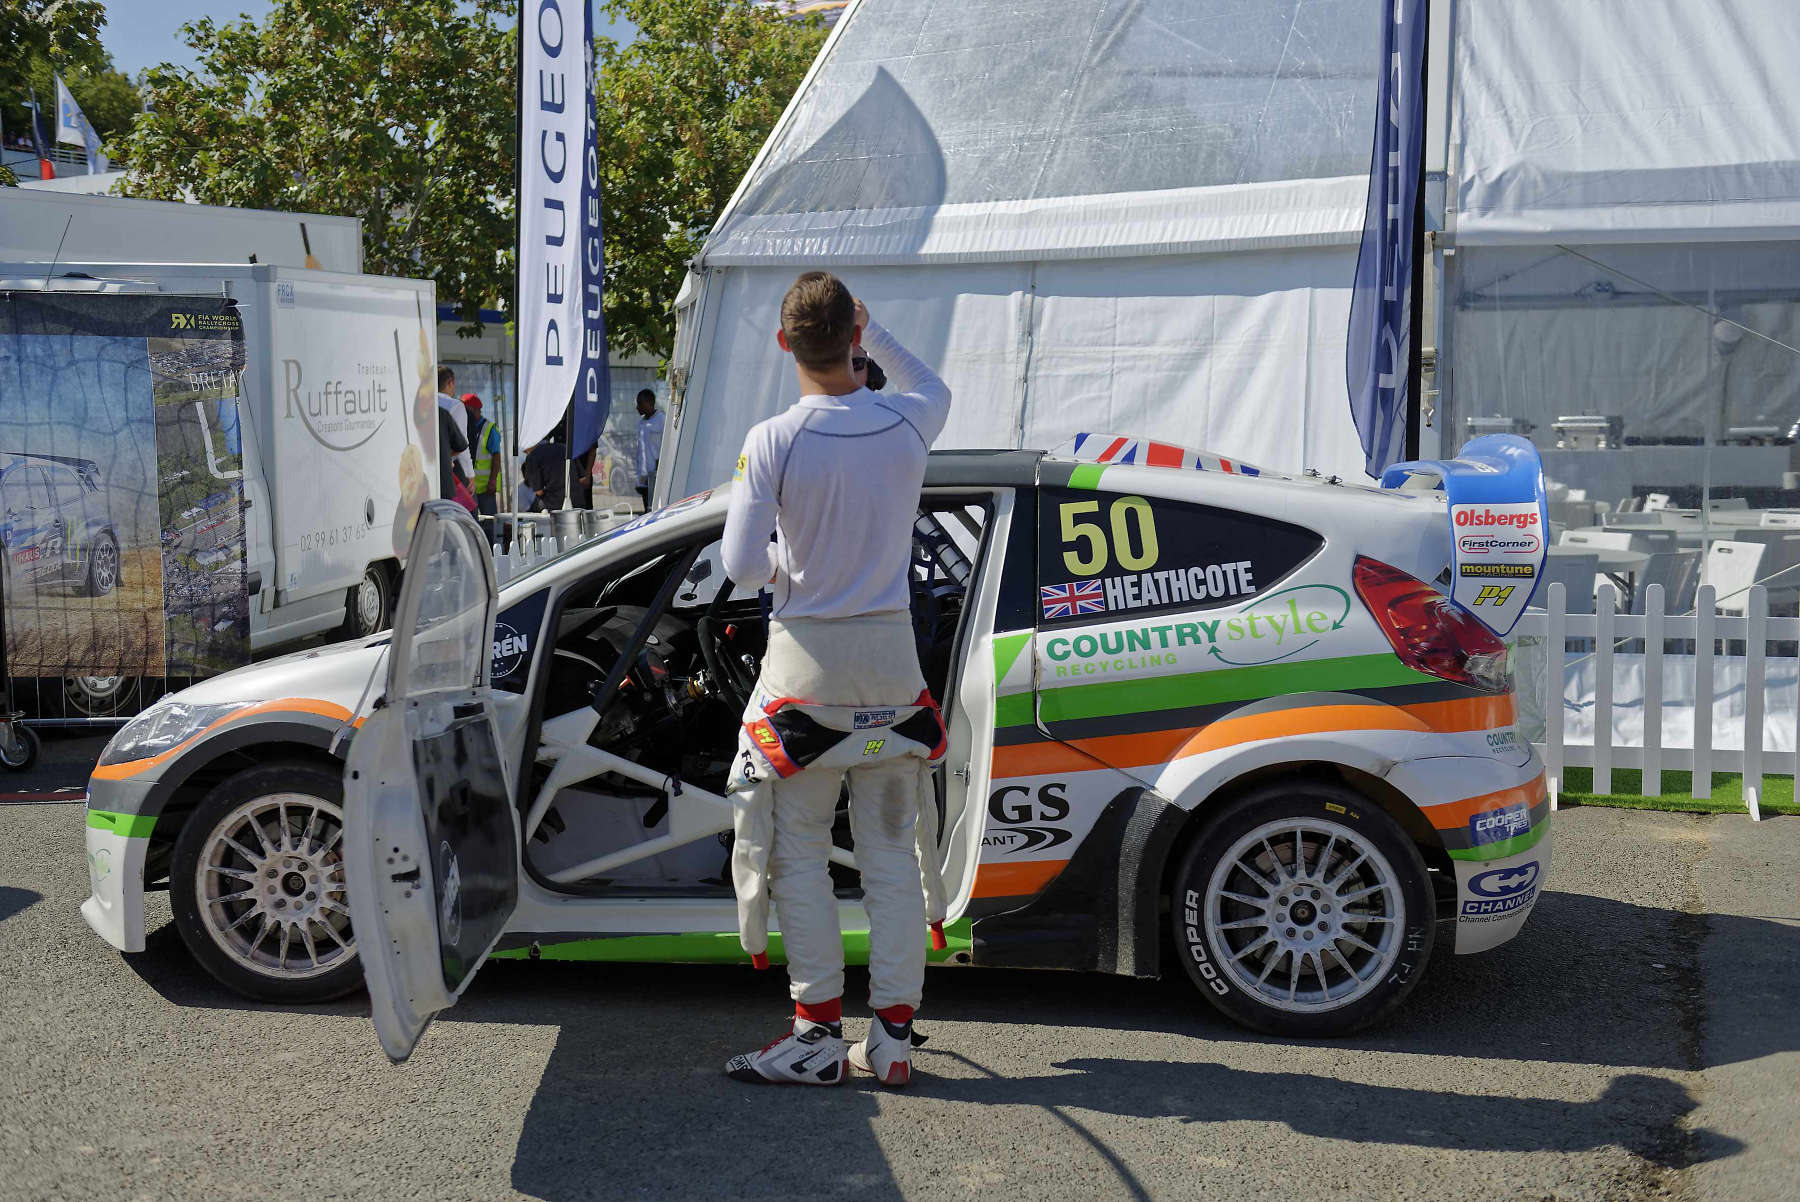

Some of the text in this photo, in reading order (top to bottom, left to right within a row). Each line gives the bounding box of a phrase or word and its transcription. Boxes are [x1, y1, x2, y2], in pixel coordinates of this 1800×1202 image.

[586, 104, 602, 403] PEUGEOT
[282, 359, 388, 419] Ruffault
[1455, 509, 1538, 529] Olsbergs
[301, 535, 312, 553] 02
[316, 531, 326, 549] 99
[330, 528, 339, 546] 61
[342, 526, 353, 543] 37
[1059, 495, 1160, 577] 50
[1462, 538, 1534, 549] FirstCorner
[1461, 564, 1533, 574] mountune
[1104, 561, 1256, 611] HEATHCOTE
[1472, 585, 1516, 606] P1
[1046, 598, 1331, 661] COUNTRY style
[1056, 653, 1178, 678] RECYCLING
[1476, 808, 1528, 832] COOPER
[1504, 819, 1528, 836] TIRES
[1465, 886, 1537, 914] CHANNEL
[1459, 913, 1491, 923] Channel
[1184, 889, 1231, 996] COOPER
